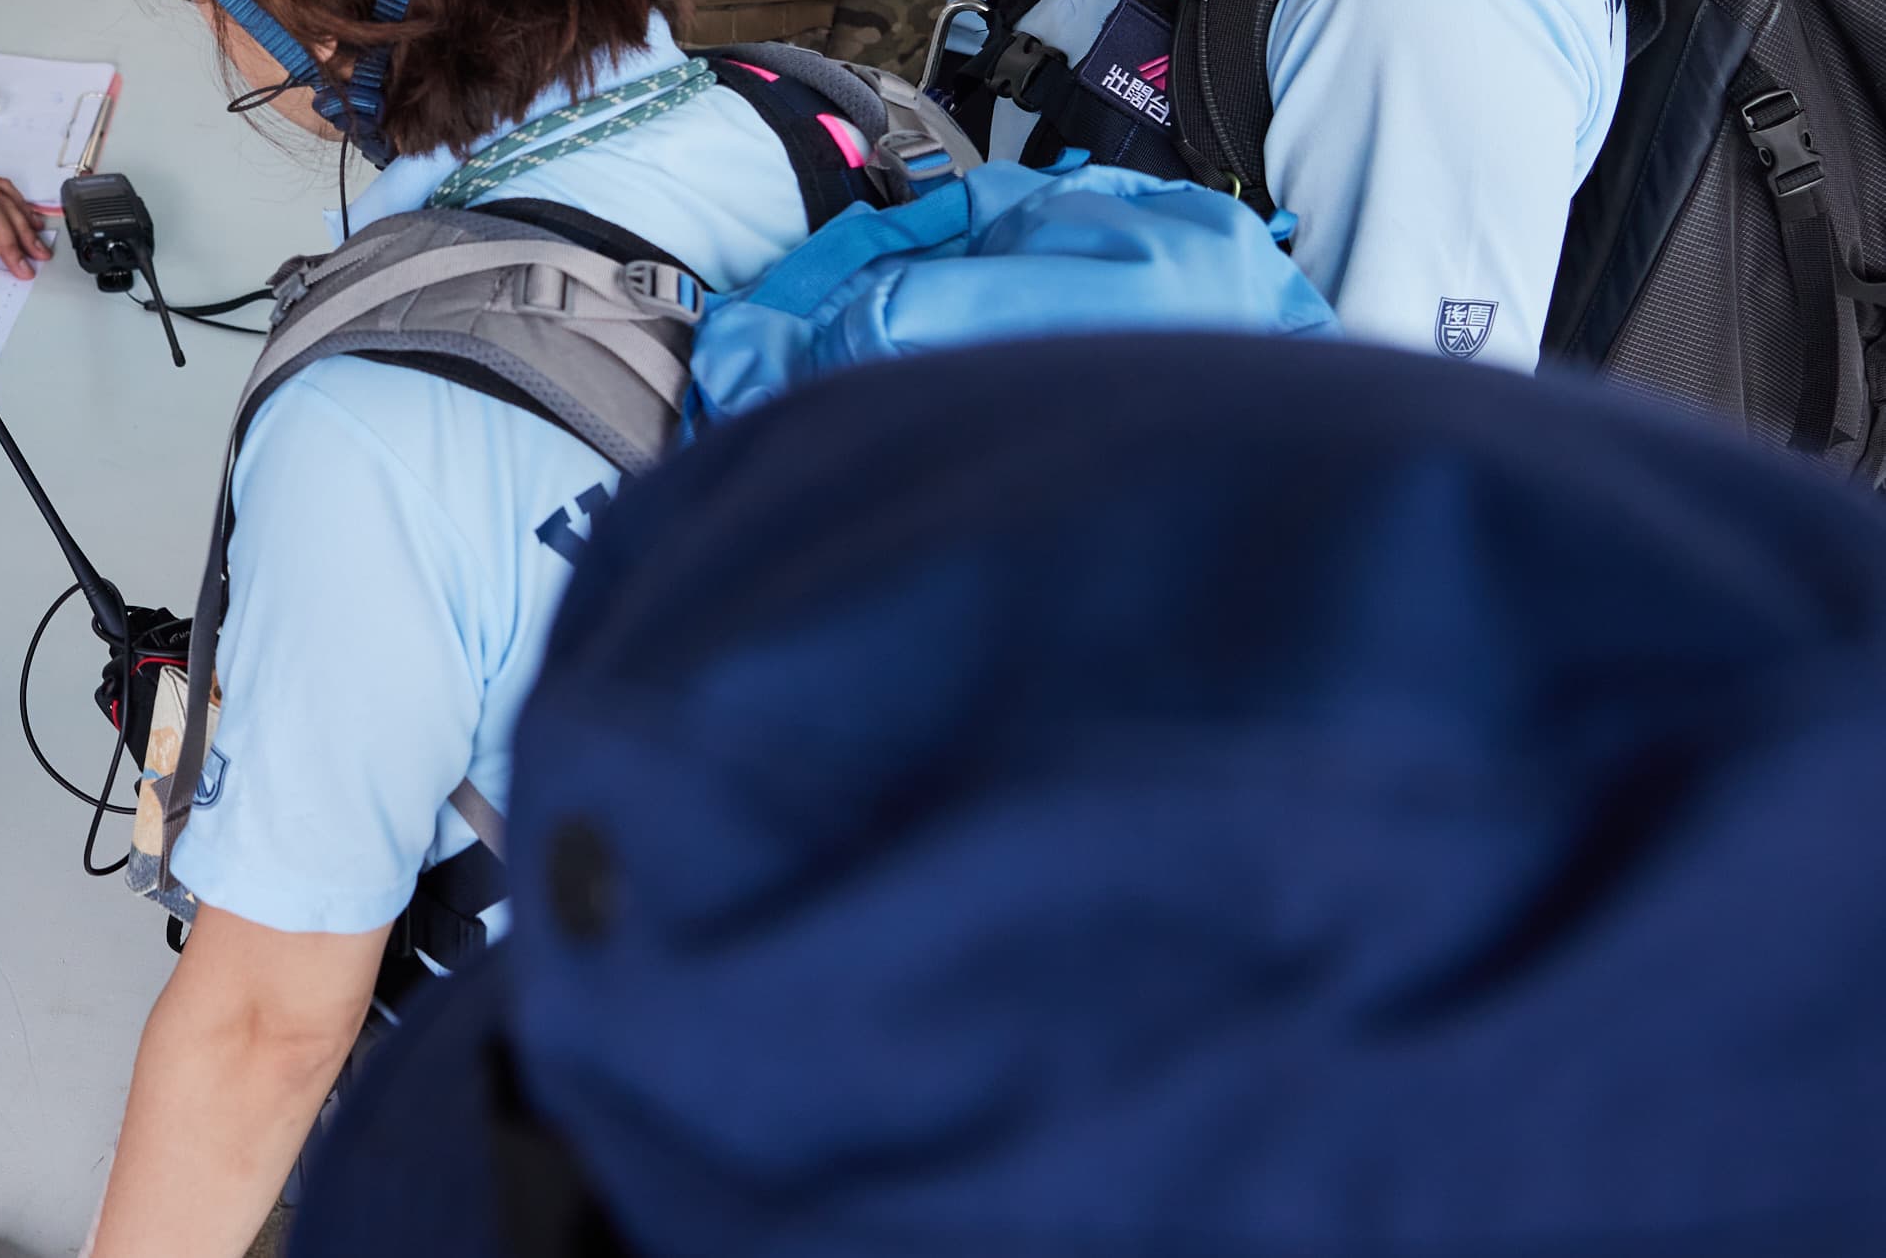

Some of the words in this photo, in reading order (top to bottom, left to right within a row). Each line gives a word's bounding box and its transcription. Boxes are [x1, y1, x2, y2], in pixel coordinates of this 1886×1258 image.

[1101, 63, 1172, 127] 壯闊台
[1444, 304, 1493, 326] 後盾
